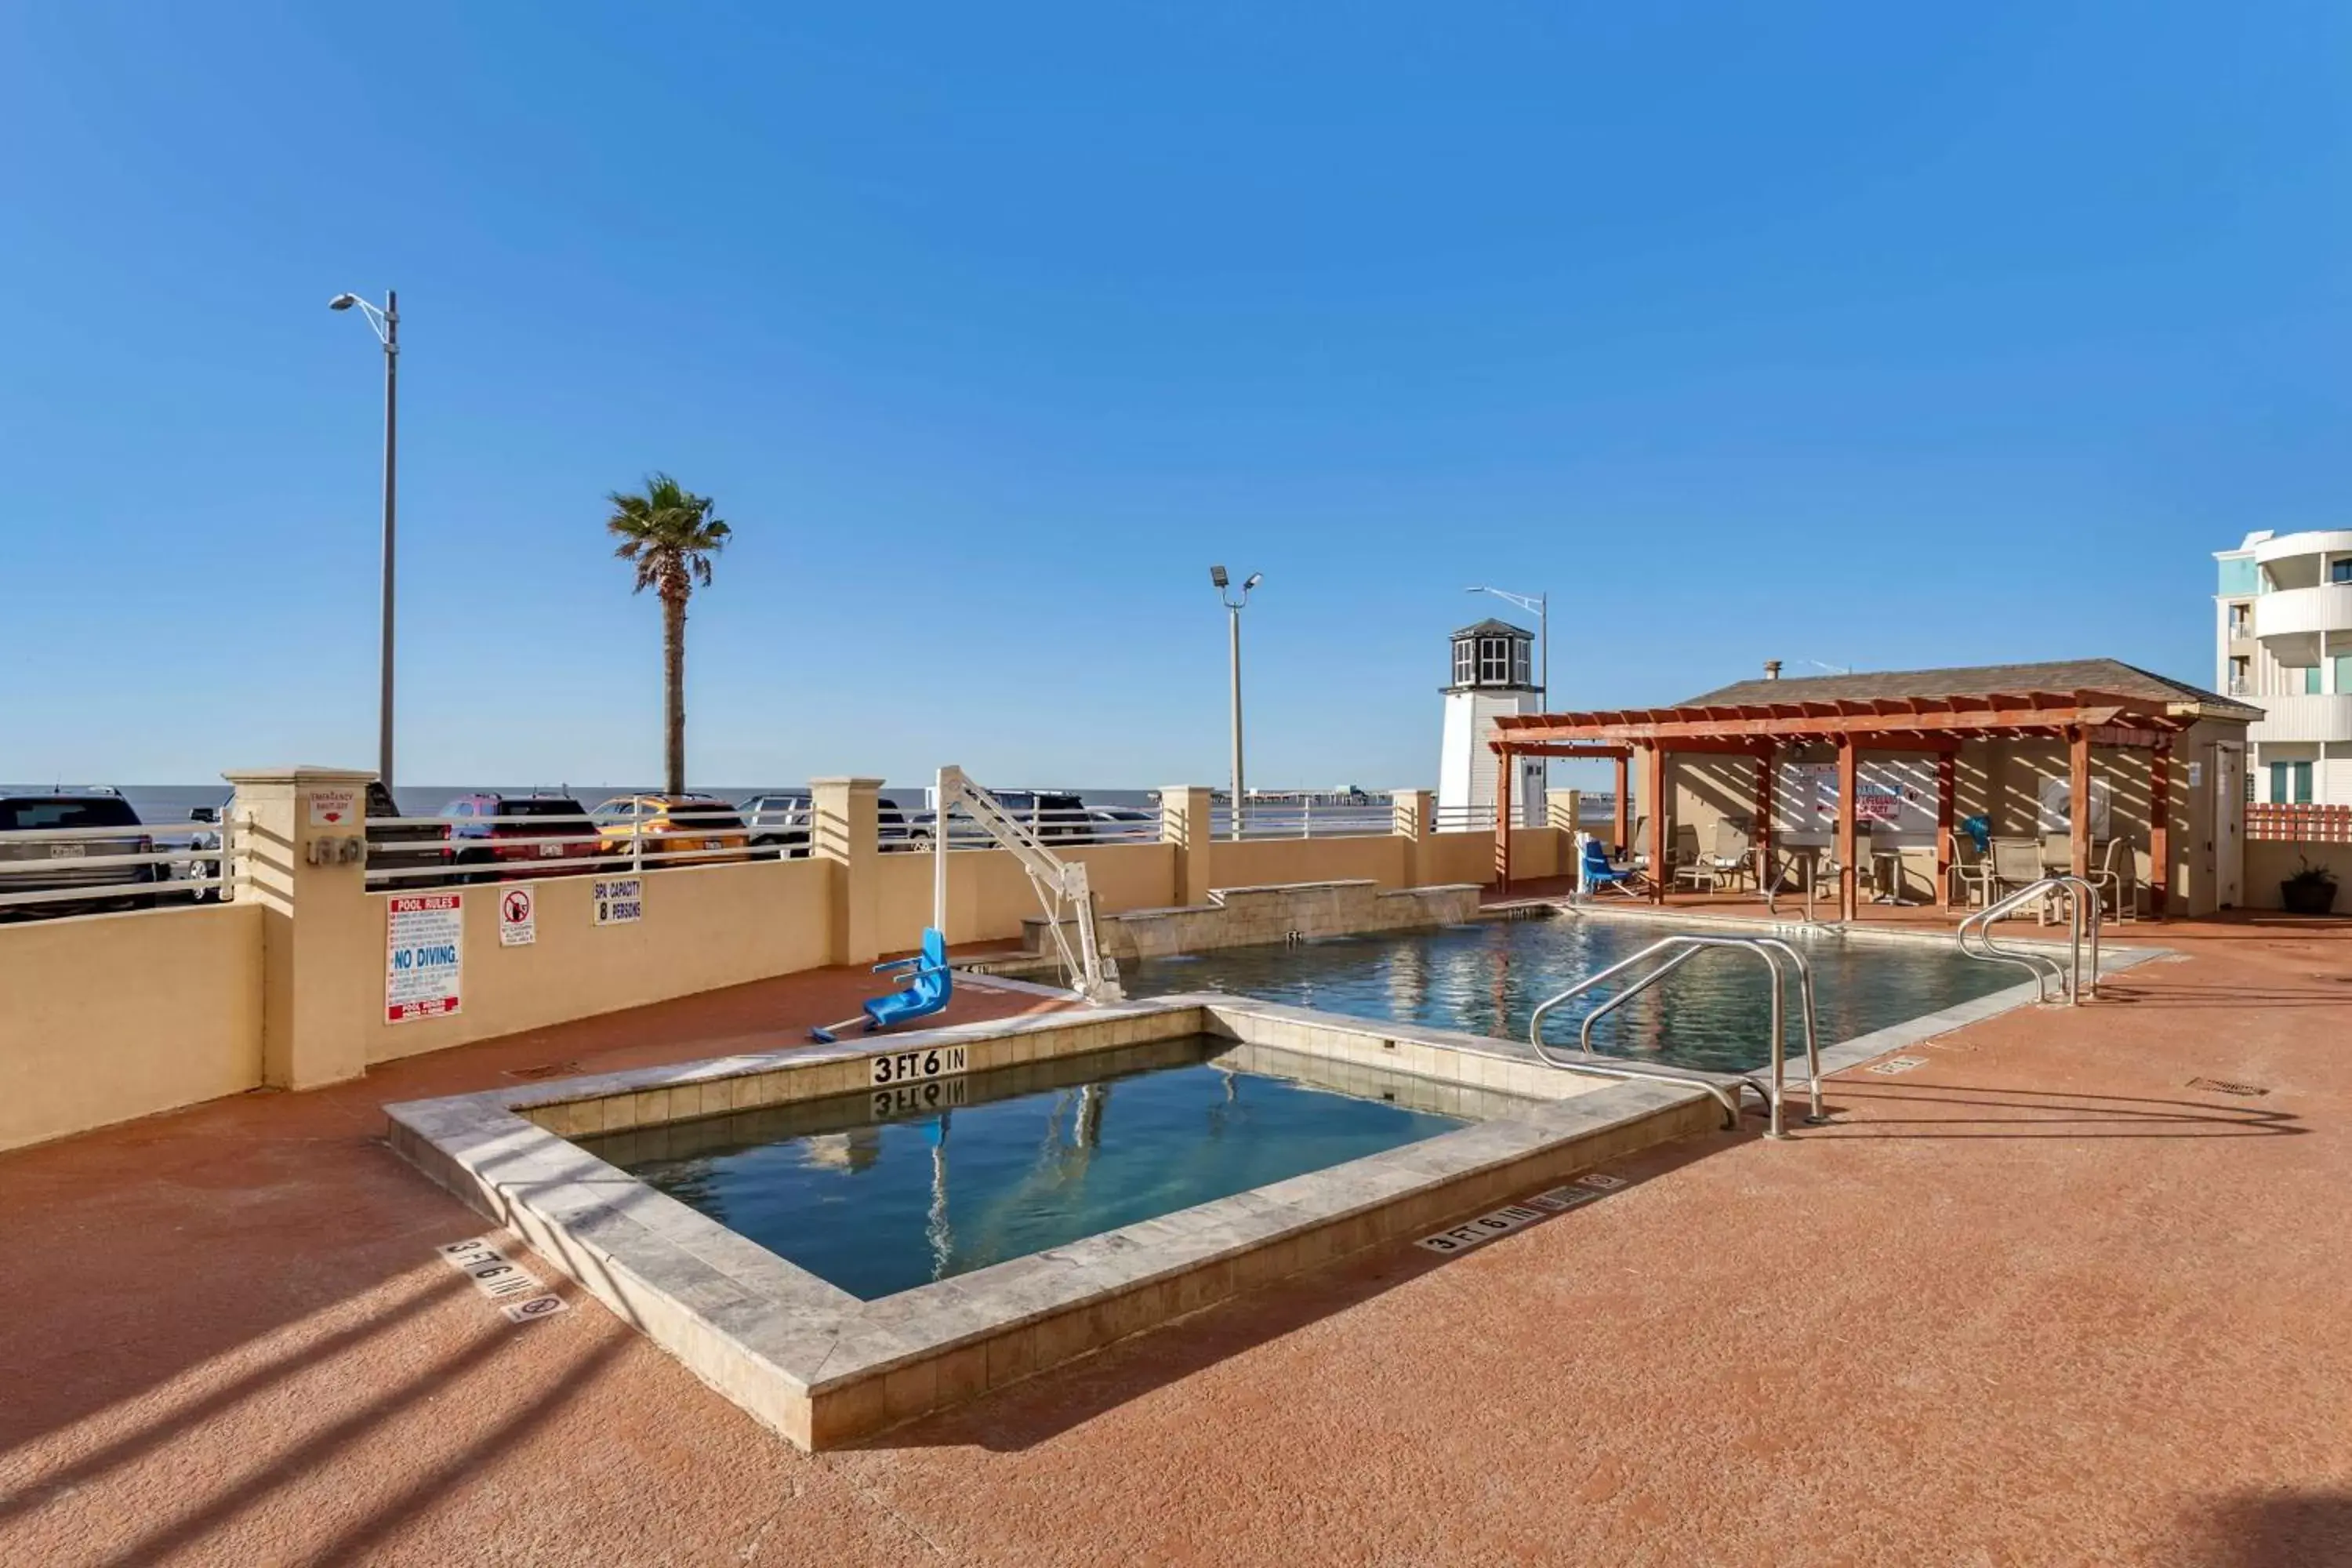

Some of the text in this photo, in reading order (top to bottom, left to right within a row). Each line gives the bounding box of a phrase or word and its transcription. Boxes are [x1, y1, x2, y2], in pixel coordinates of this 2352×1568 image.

[311, 791, 353, 800] EMERGENCY
[595, 880, 640, 898] SPA CAPACITY
[398, 896, 452, 911] POOL RULES
[601, 902, 641, 920] 8 PERSONS
[395, 949, 412, 969] NO
